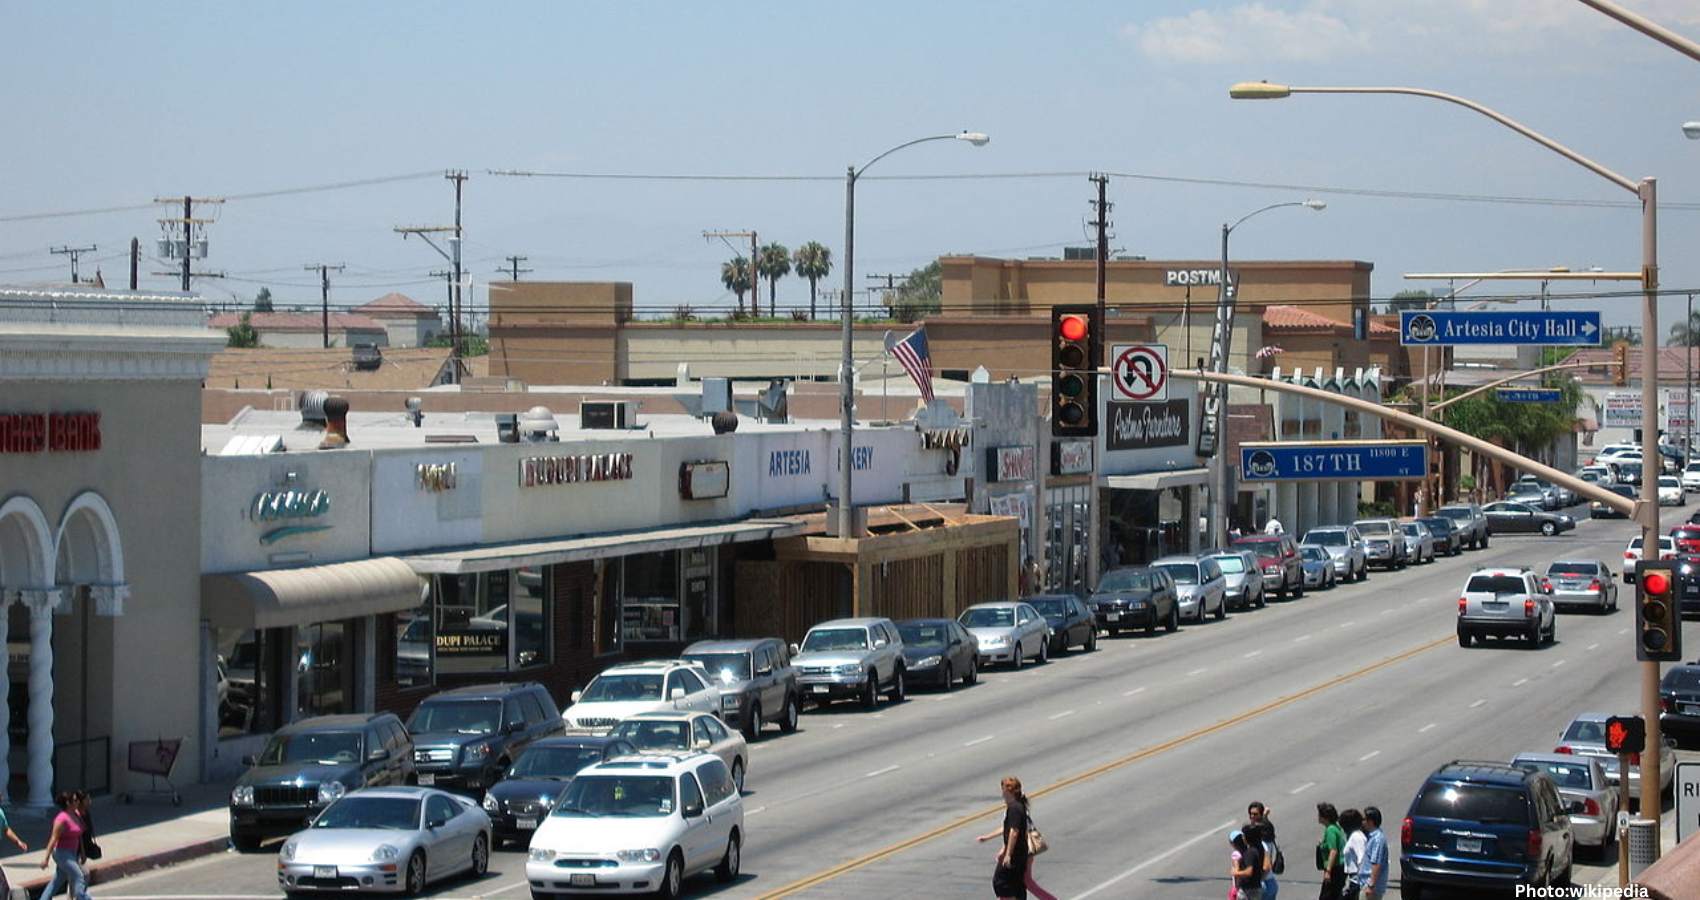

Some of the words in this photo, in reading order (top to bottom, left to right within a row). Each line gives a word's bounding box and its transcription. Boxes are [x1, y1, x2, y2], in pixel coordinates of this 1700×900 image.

[1444, 319, 1503, 337] Artesia
[1508, 319, 1540, 340] City
[1546, 319, 1576, 337] Hall
[49, 411, 102, 451] BANK
[1143, 406, 1181, 444] Furniture
[579, 453, 633, 483] PALACE
[769, 449, 811, 477] ARTESIA
[837, 446, 873, 472] KERY
[1293, 453, 1361, 472] 187TH
[1370, 448, 1397, 458] 11800
[1402, 448, 1409, 457] E
[463, 635, 500, 646] PALACE
